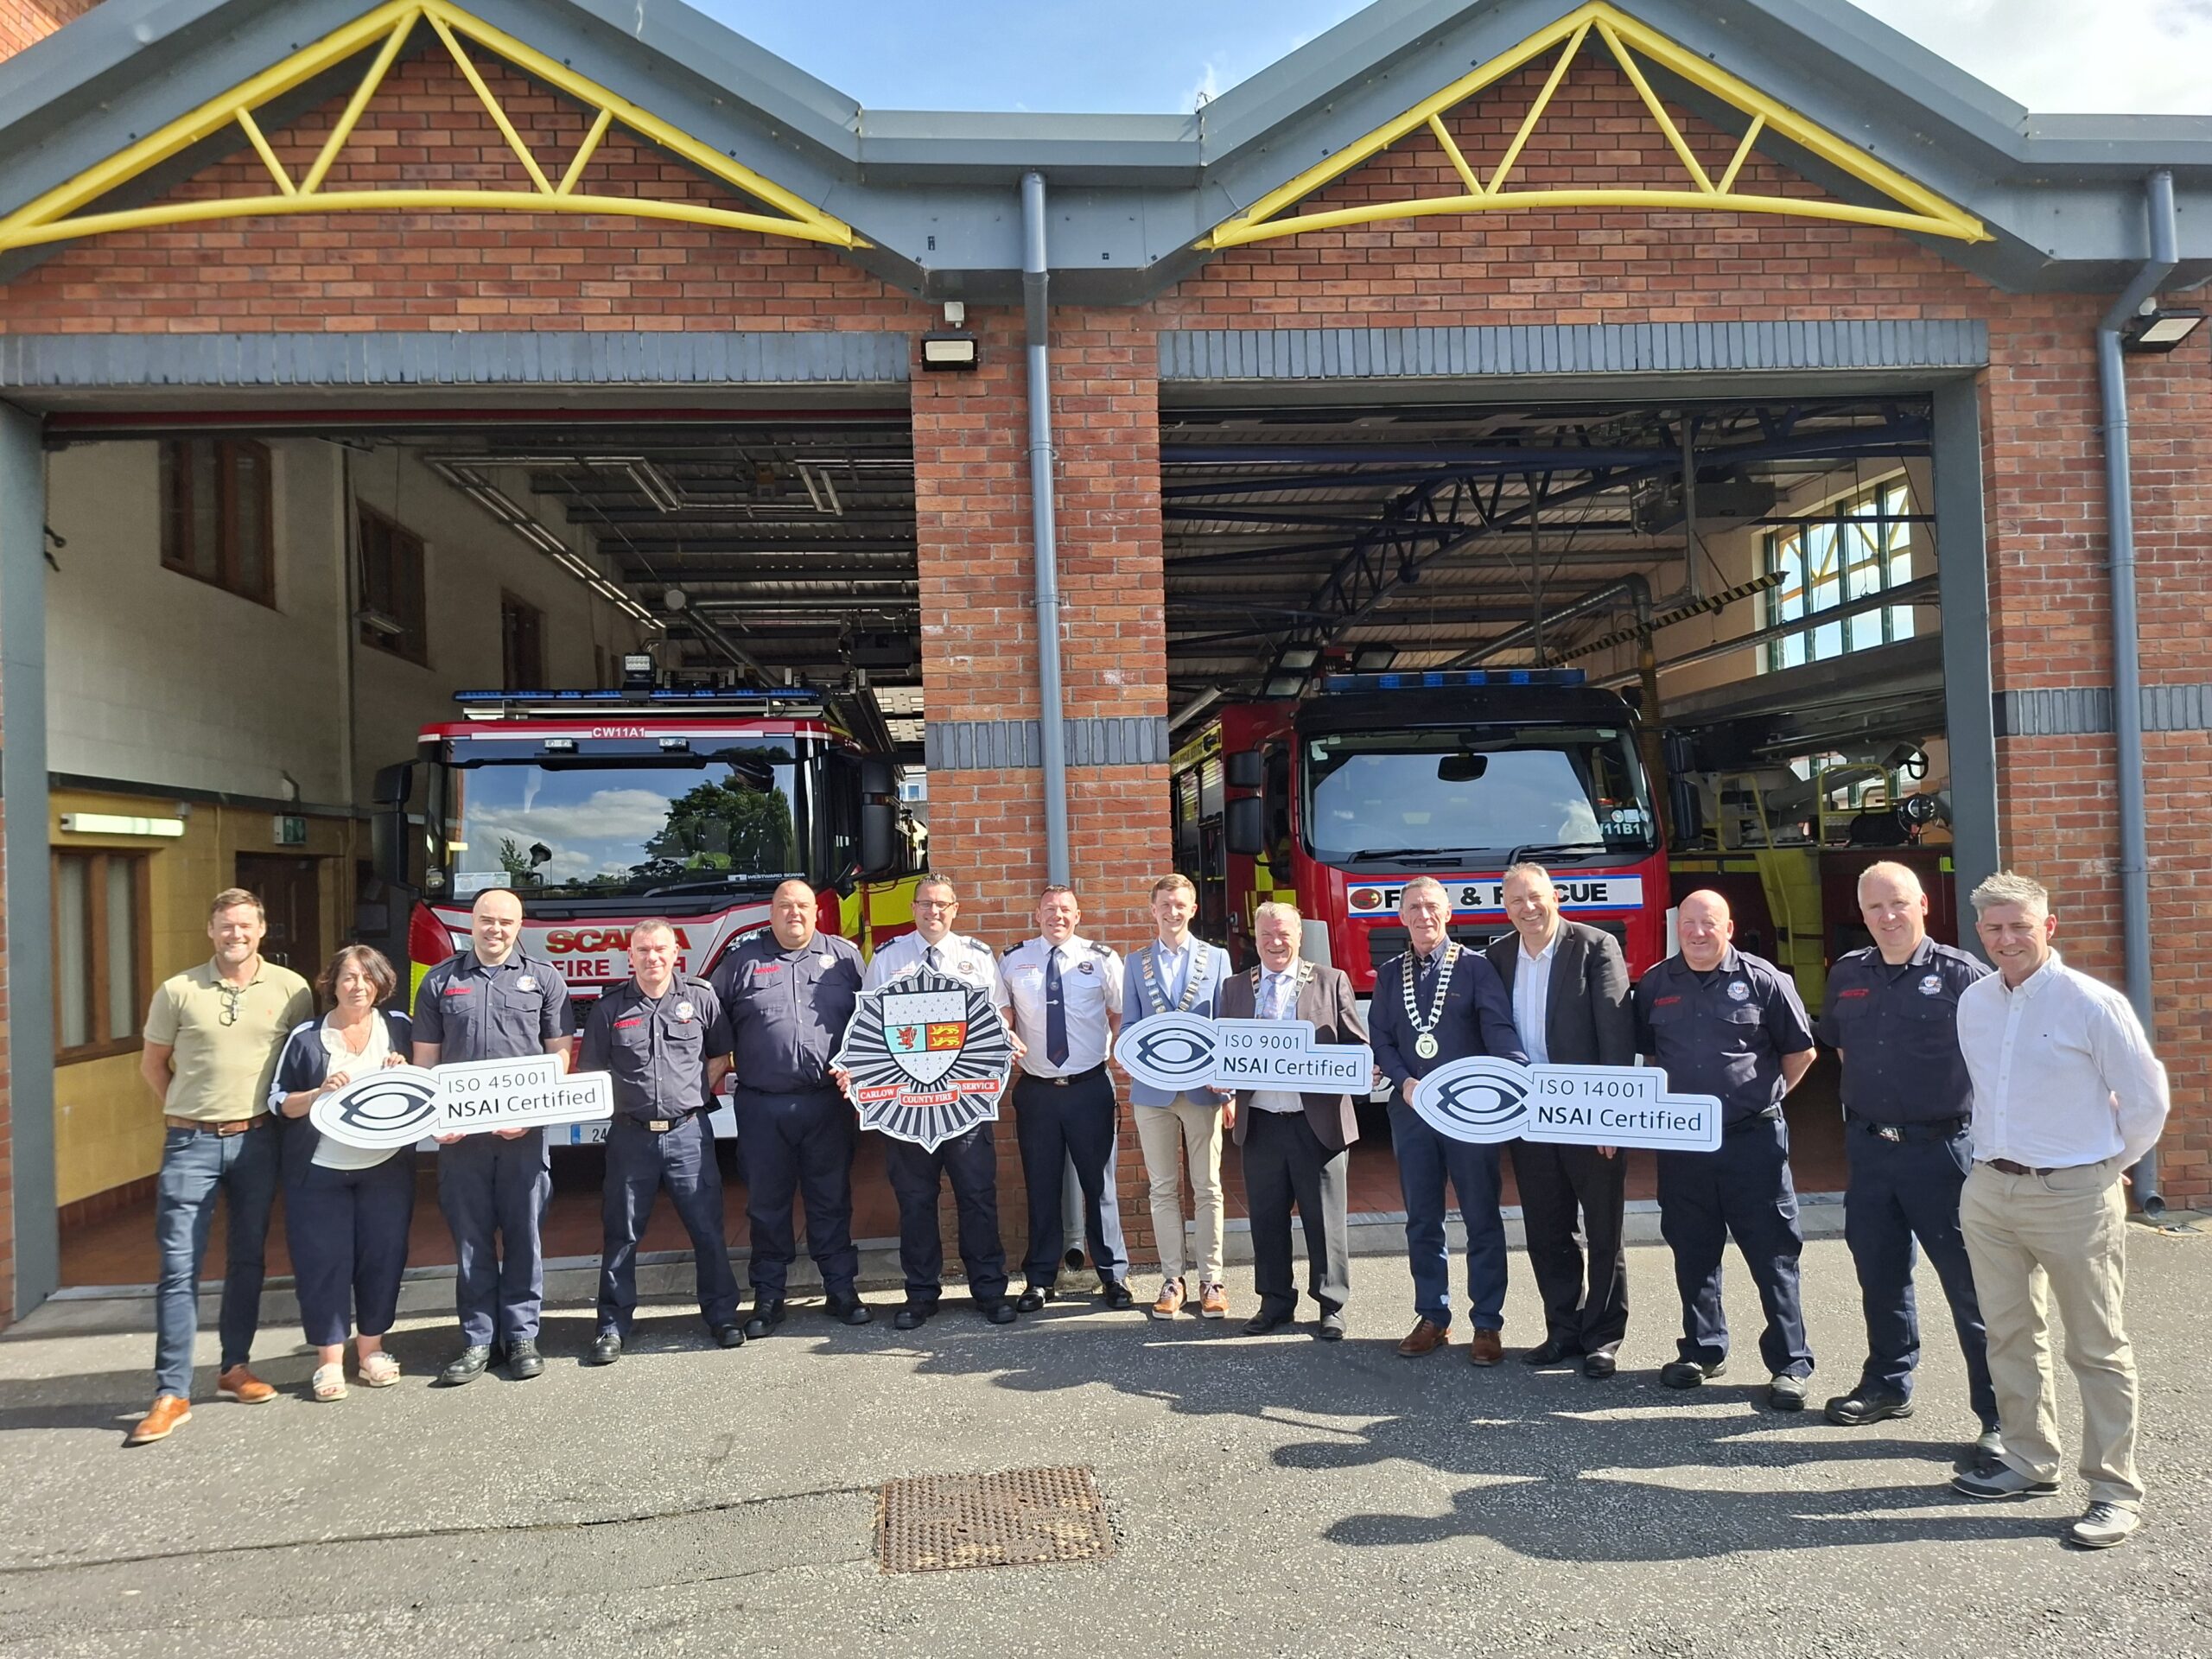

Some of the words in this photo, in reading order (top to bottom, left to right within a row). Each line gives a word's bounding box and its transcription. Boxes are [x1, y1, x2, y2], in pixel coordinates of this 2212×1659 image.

[593, 727, 645, 738] CW11A1
[1580, 823, 1641, 836] CW11B1
[1460, 887, 1483, 906] &
[1225, 1033, 1253, 1048] ISO
[1260, 1035, 1300, 1050] 9001
[1224, 1057, 1268, 1074] NSAI
[1274, 1058, 1357, 1077] Certified
[448, 1077, 480, 1094] ISO
[488, 1071, 546, 1089] 45001
[1540, 1079, 1574, 1095] ISO
[1583, 1081, 1643, 1098] 14001
[860, 1089, 894, 1099] CARLOW
[902, 1095, 934, 1103] COUNTY
[935, 1092, 953, 1102] FIRE
[962, 1082, 995, 1090] SERVICE
[448, 1098, 499, 1119] NSAI
[507, 1087, 596, 1112] Certified
[1538, 1106, 1592, 1126] NSAI
[1600, 1109, 1701, 1131] Certified
